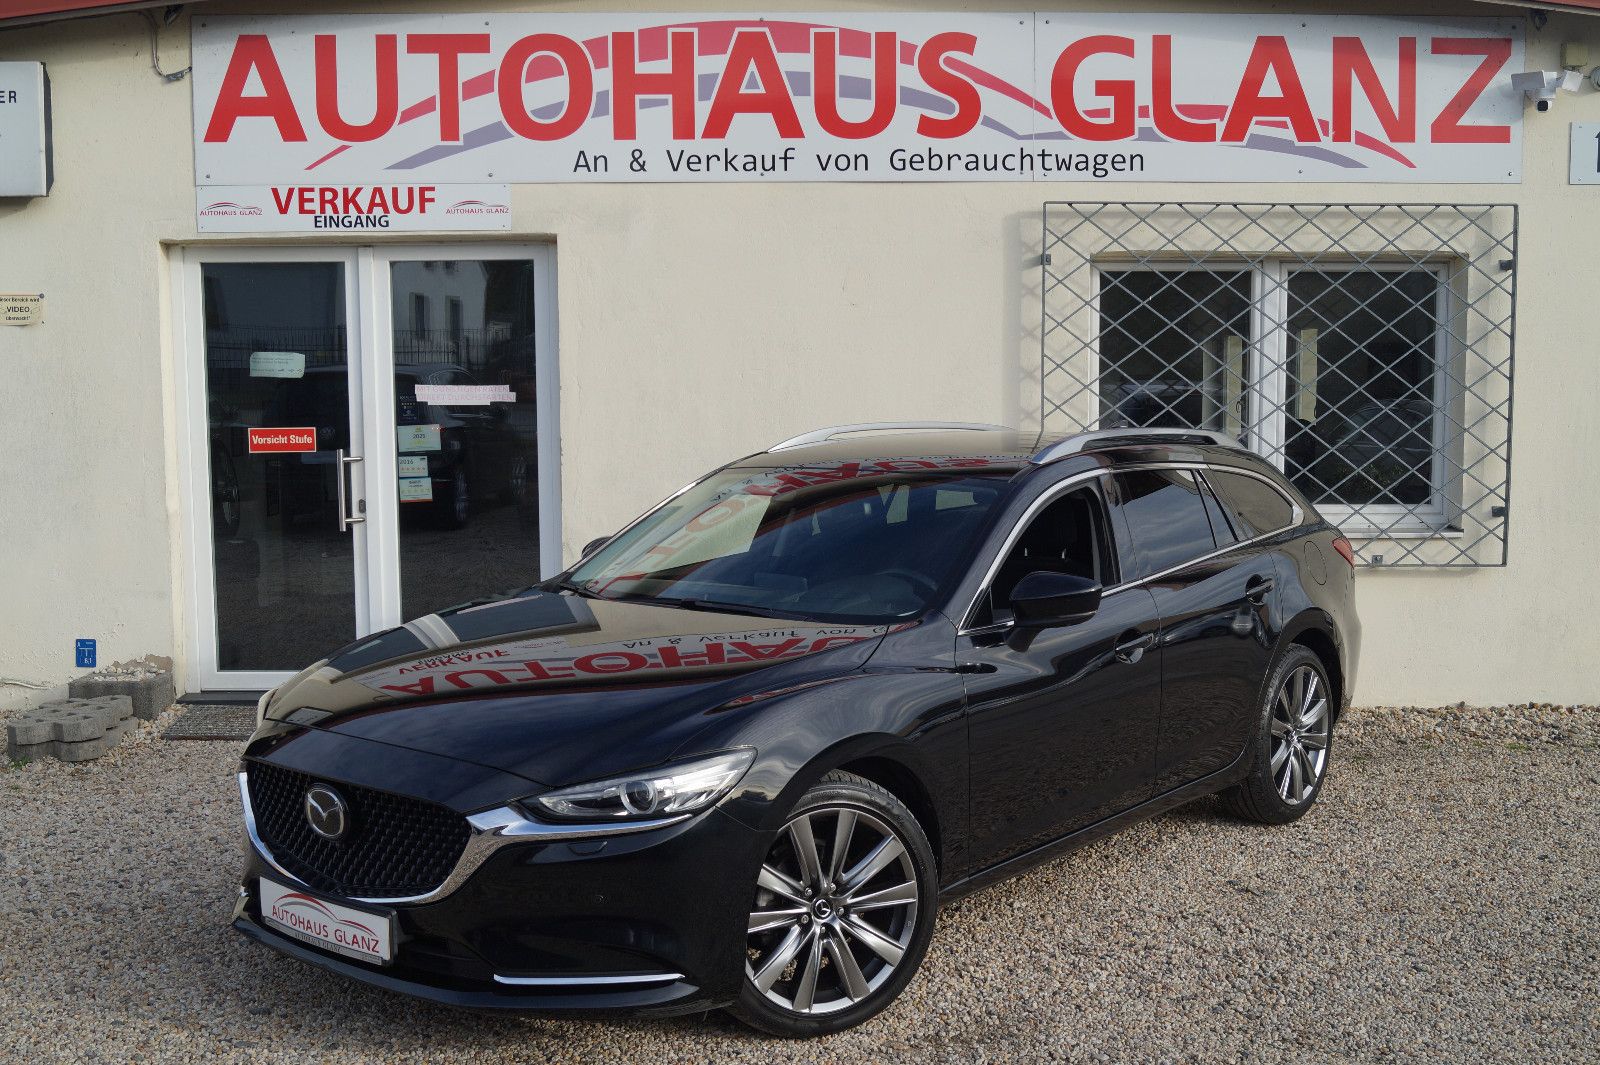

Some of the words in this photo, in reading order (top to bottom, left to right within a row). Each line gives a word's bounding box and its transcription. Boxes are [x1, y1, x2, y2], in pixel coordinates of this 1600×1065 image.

[203, 31, 982, 143] AUTOHAUS
[1050, 34, 1512, 143] GLANZ
[573, 150, 608, 172] An
[629, 149, 648, 172] &
[666, 147, 796, 172] Verkauf
[816, 153, 869, 172] von
[889, 147, 1144, 178] Gebrauchtwagen
[270, 186, 435, 215] VERKAUF
[314, 215, 390, 229] EINGANG
[252, 435, 288, 445] Vorsicht
[289, 434, 313, 444] Stufe
[272, 904, 329, 938] AUTOHAUS
[334, 928, 380, 954] GLANZ
